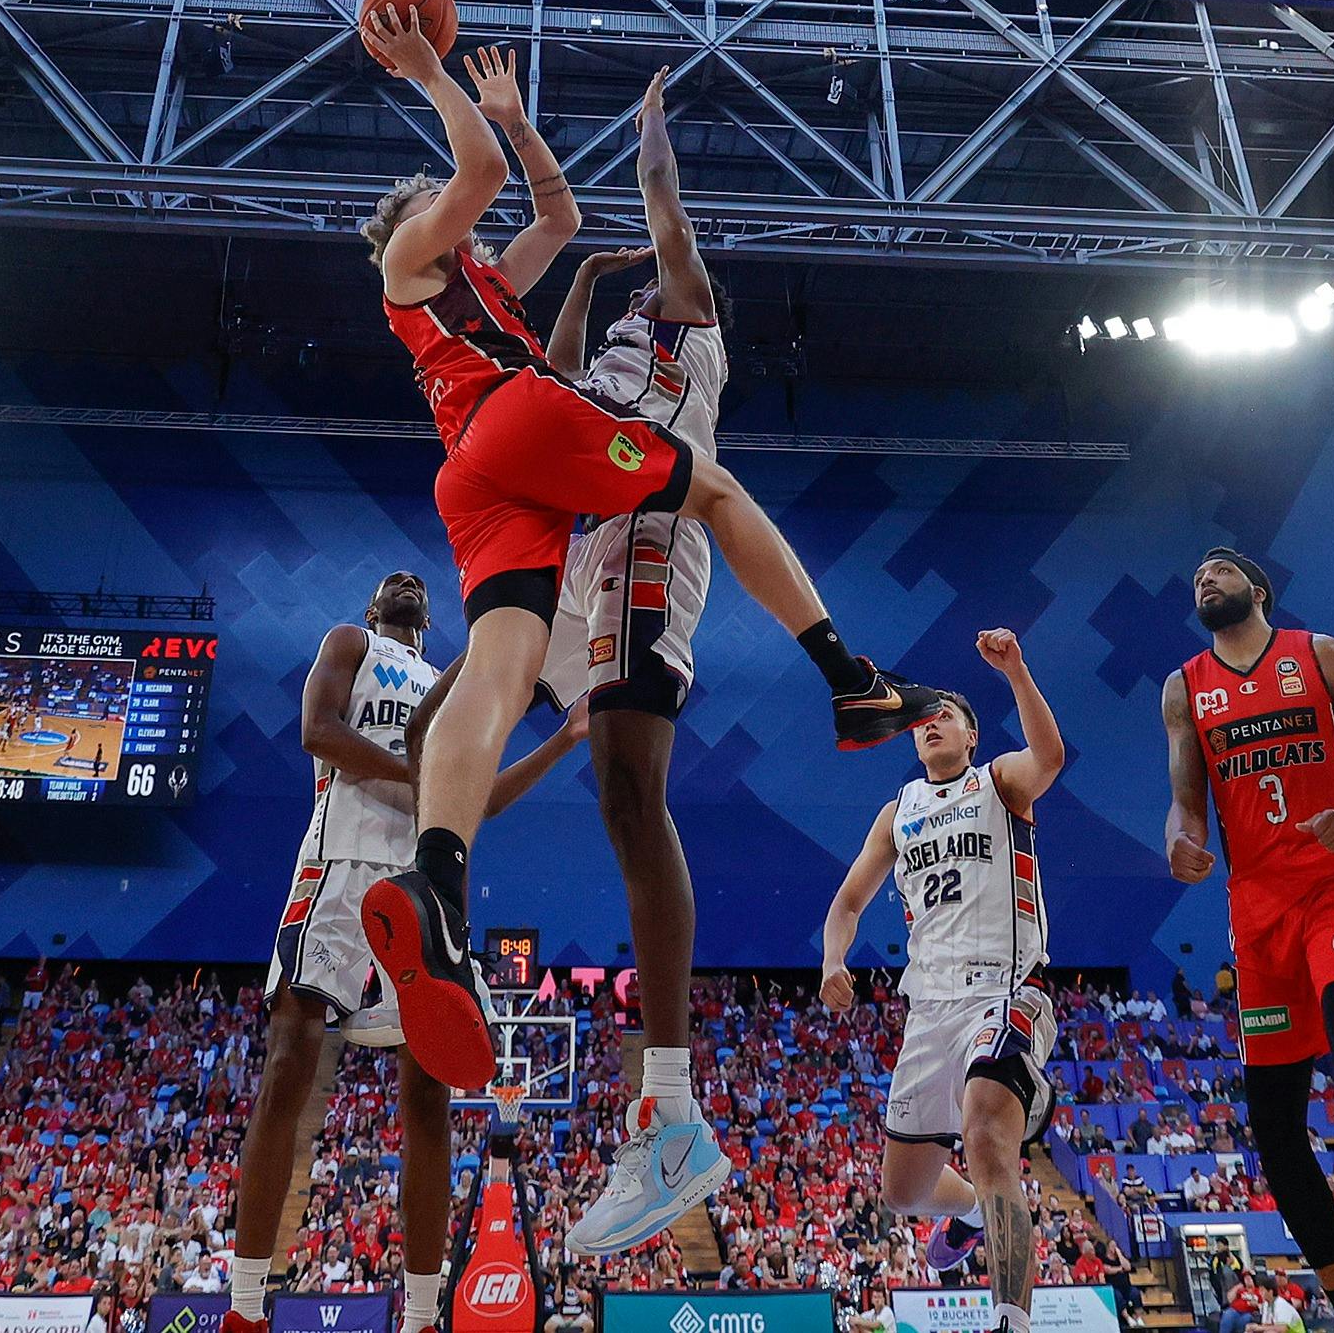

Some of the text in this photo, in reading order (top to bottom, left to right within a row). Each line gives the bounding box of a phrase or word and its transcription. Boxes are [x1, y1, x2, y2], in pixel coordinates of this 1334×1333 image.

[39, 643, 122, 656] MADE SIMPLE
[43, 633, 122, 647] IT'S THE GYM,
[1212, 705, 1229, 716] bank
[1231, 714, 1313, 740] PENTANET
[1216, 741, 1326, 783] WILDCATS
[126, 763, 156, 797] 66
[1259, 773, 1287, 825] 3
[929, 805, 981, 829] walker
[923, 868, 962, 911] 22
[501, 938, 531, 956] 8:48
[513, 957, 527, 984] 7
[489, 1219, 507, 1233] IGA
[470, 1273, 521, 1306] IGA
[942, 1308, 989, 1321] BUCKETS
